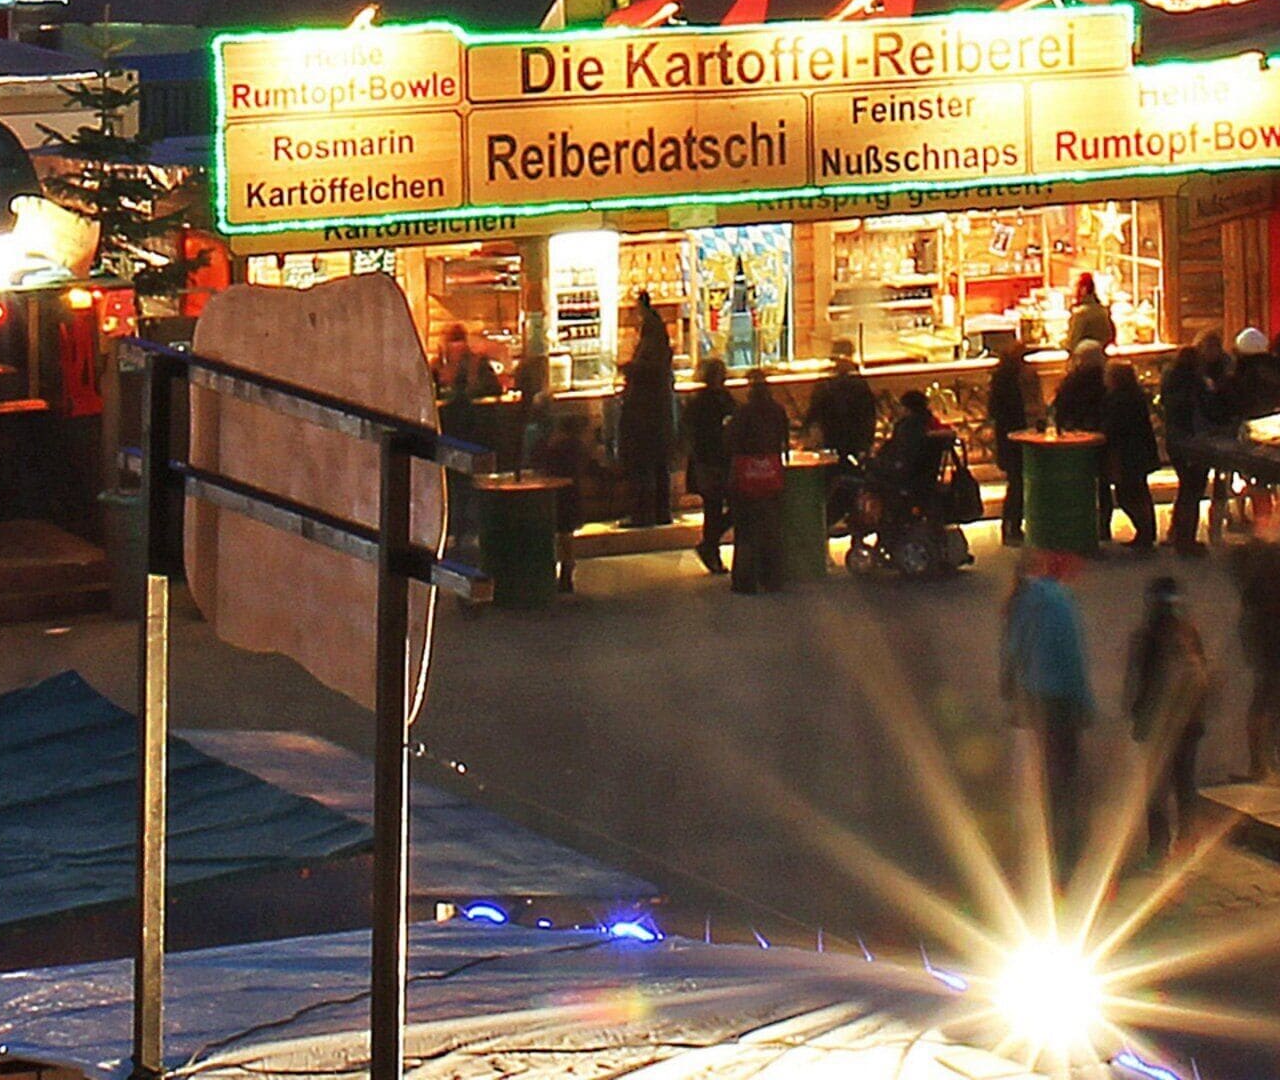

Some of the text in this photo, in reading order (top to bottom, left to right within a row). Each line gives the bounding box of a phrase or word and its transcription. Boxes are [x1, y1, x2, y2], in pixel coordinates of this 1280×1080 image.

[520, 22, 1076, 95] Die Kartoffel-Reiberei
[231, 71, 456, 111] Rumtopf-Bowle
[852, 92, 975, 124] Feinster
[273, 129, 415, 162] Rosmarin
[487, 119, 787, 181] Reiberdatschi
[821, 142, 1018, 177] Nußschnaps
[246, 173, 445, 209] Kartöffelchen
